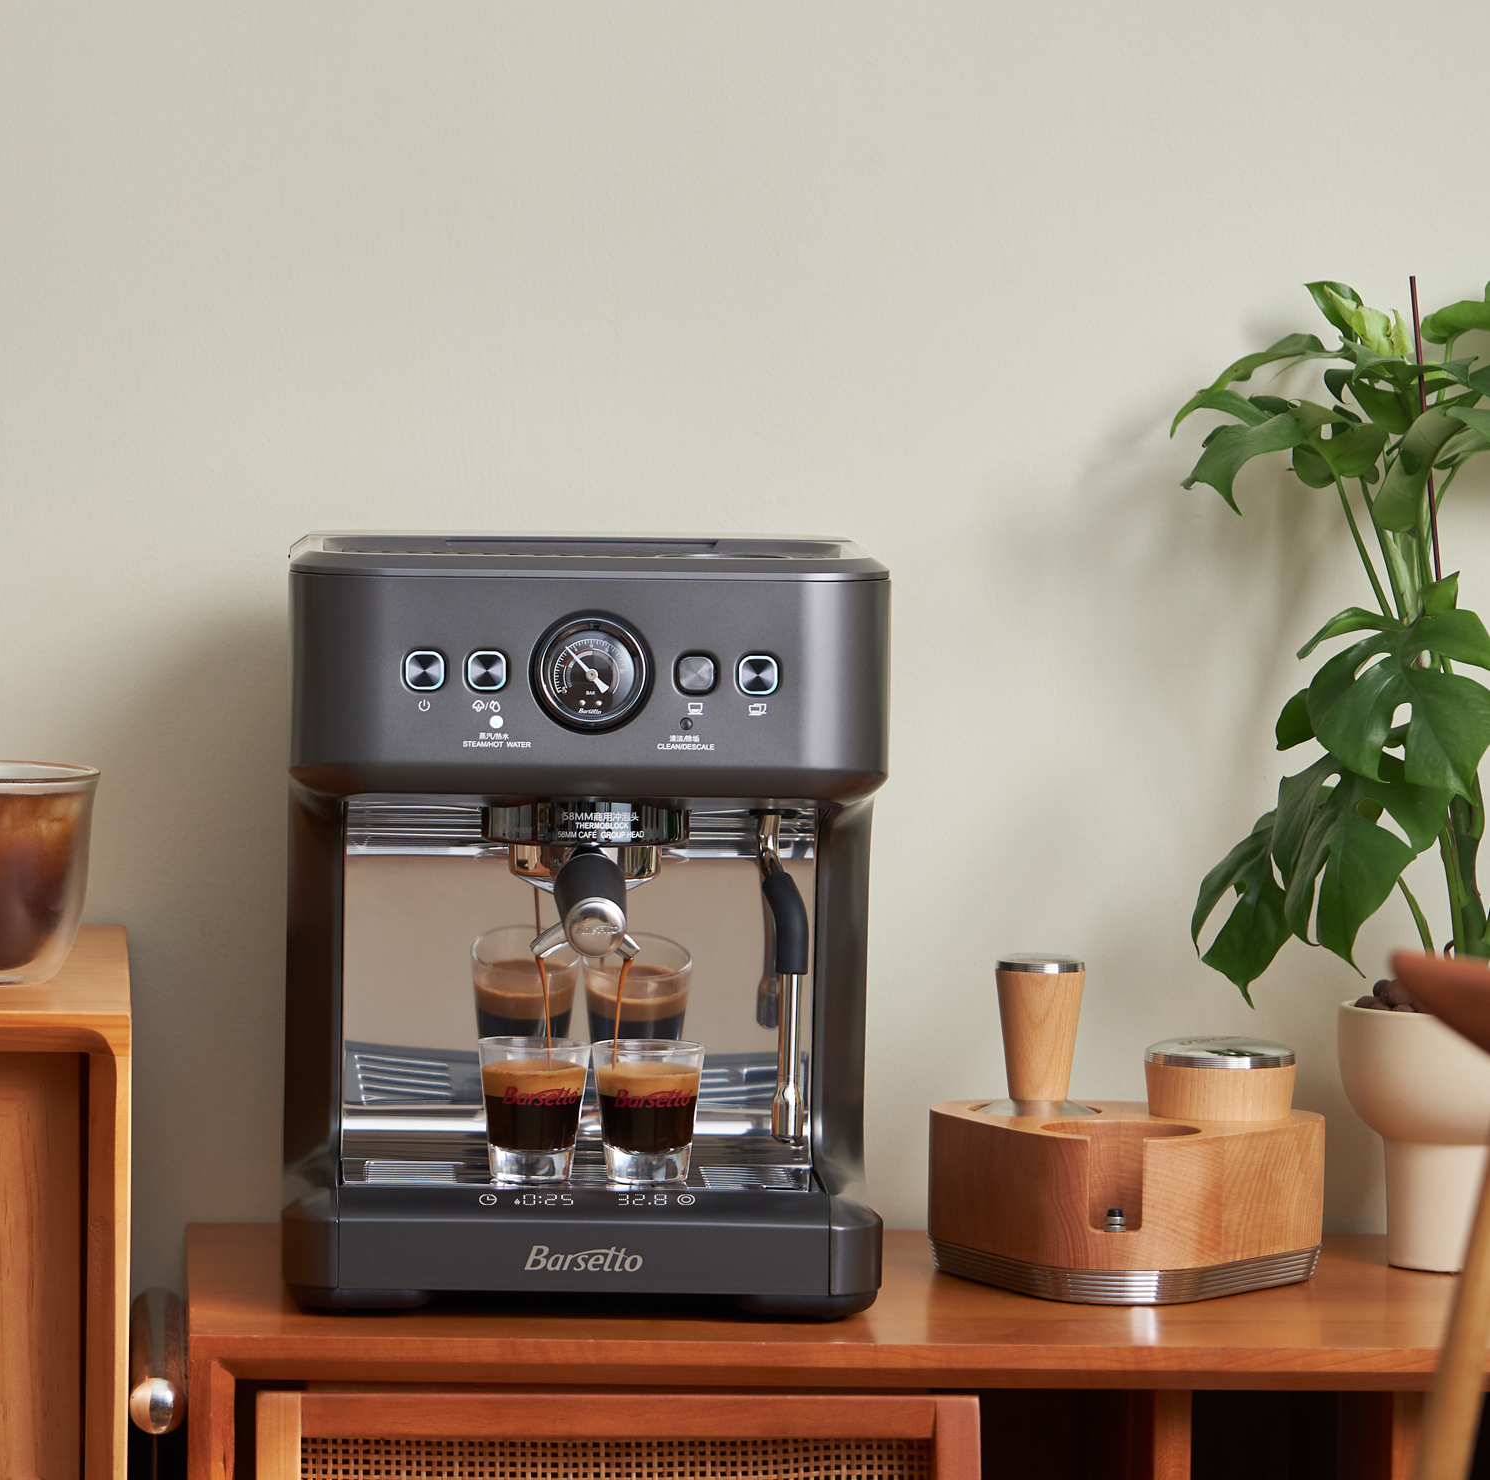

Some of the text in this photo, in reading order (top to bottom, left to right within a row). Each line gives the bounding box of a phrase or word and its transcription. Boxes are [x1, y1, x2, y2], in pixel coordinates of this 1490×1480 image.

[657, 743, 715, 751] CLEAN/DESCALE
[502, 1086, 579, 1106] Barsetto
[614, 1089, 692, 1108] Barsetto
[523, 1194, 574, 1206] 0:25
[618, 1194, 667, 1206] 32.8
[524, 1245, 643, 1272] Barsetto
